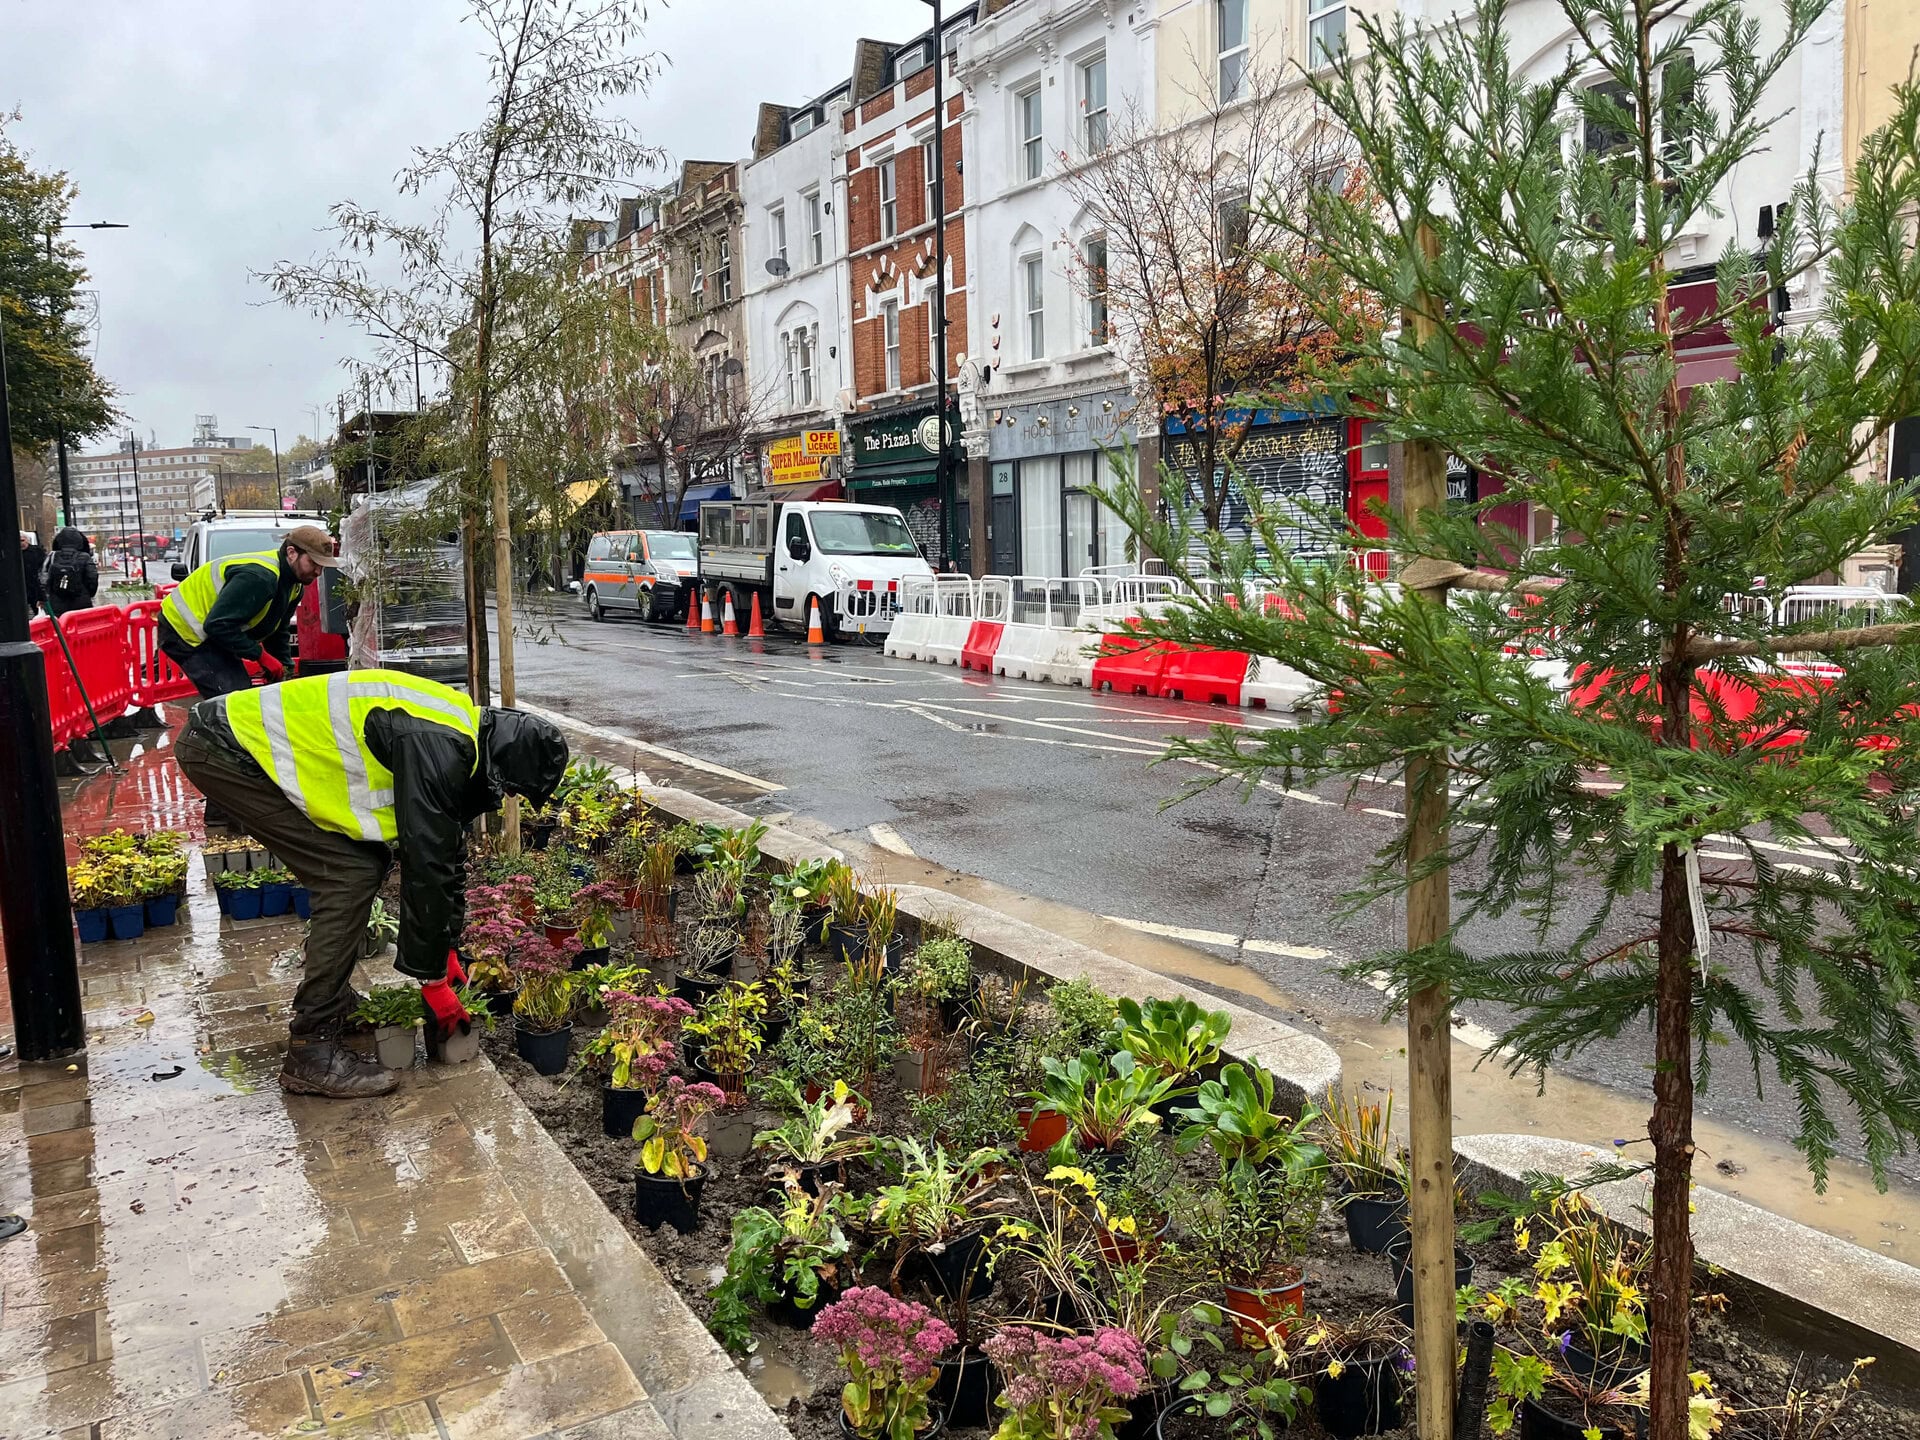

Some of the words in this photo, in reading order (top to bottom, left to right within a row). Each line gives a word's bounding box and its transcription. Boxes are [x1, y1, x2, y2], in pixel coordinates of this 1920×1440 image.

[1023, 423, 1058, 440] HOUSE
[1085, 410, 1135, 430] VINTA
[809, 432, 834, 442] OFF
[864, 436, 880, 450] The
[882, 432, 910, 448] Pizza
[808, 442, 838, 450] LICENCE
[772, 453, 792, 469] SUPER
[999, 472, 1008, 482] 28
